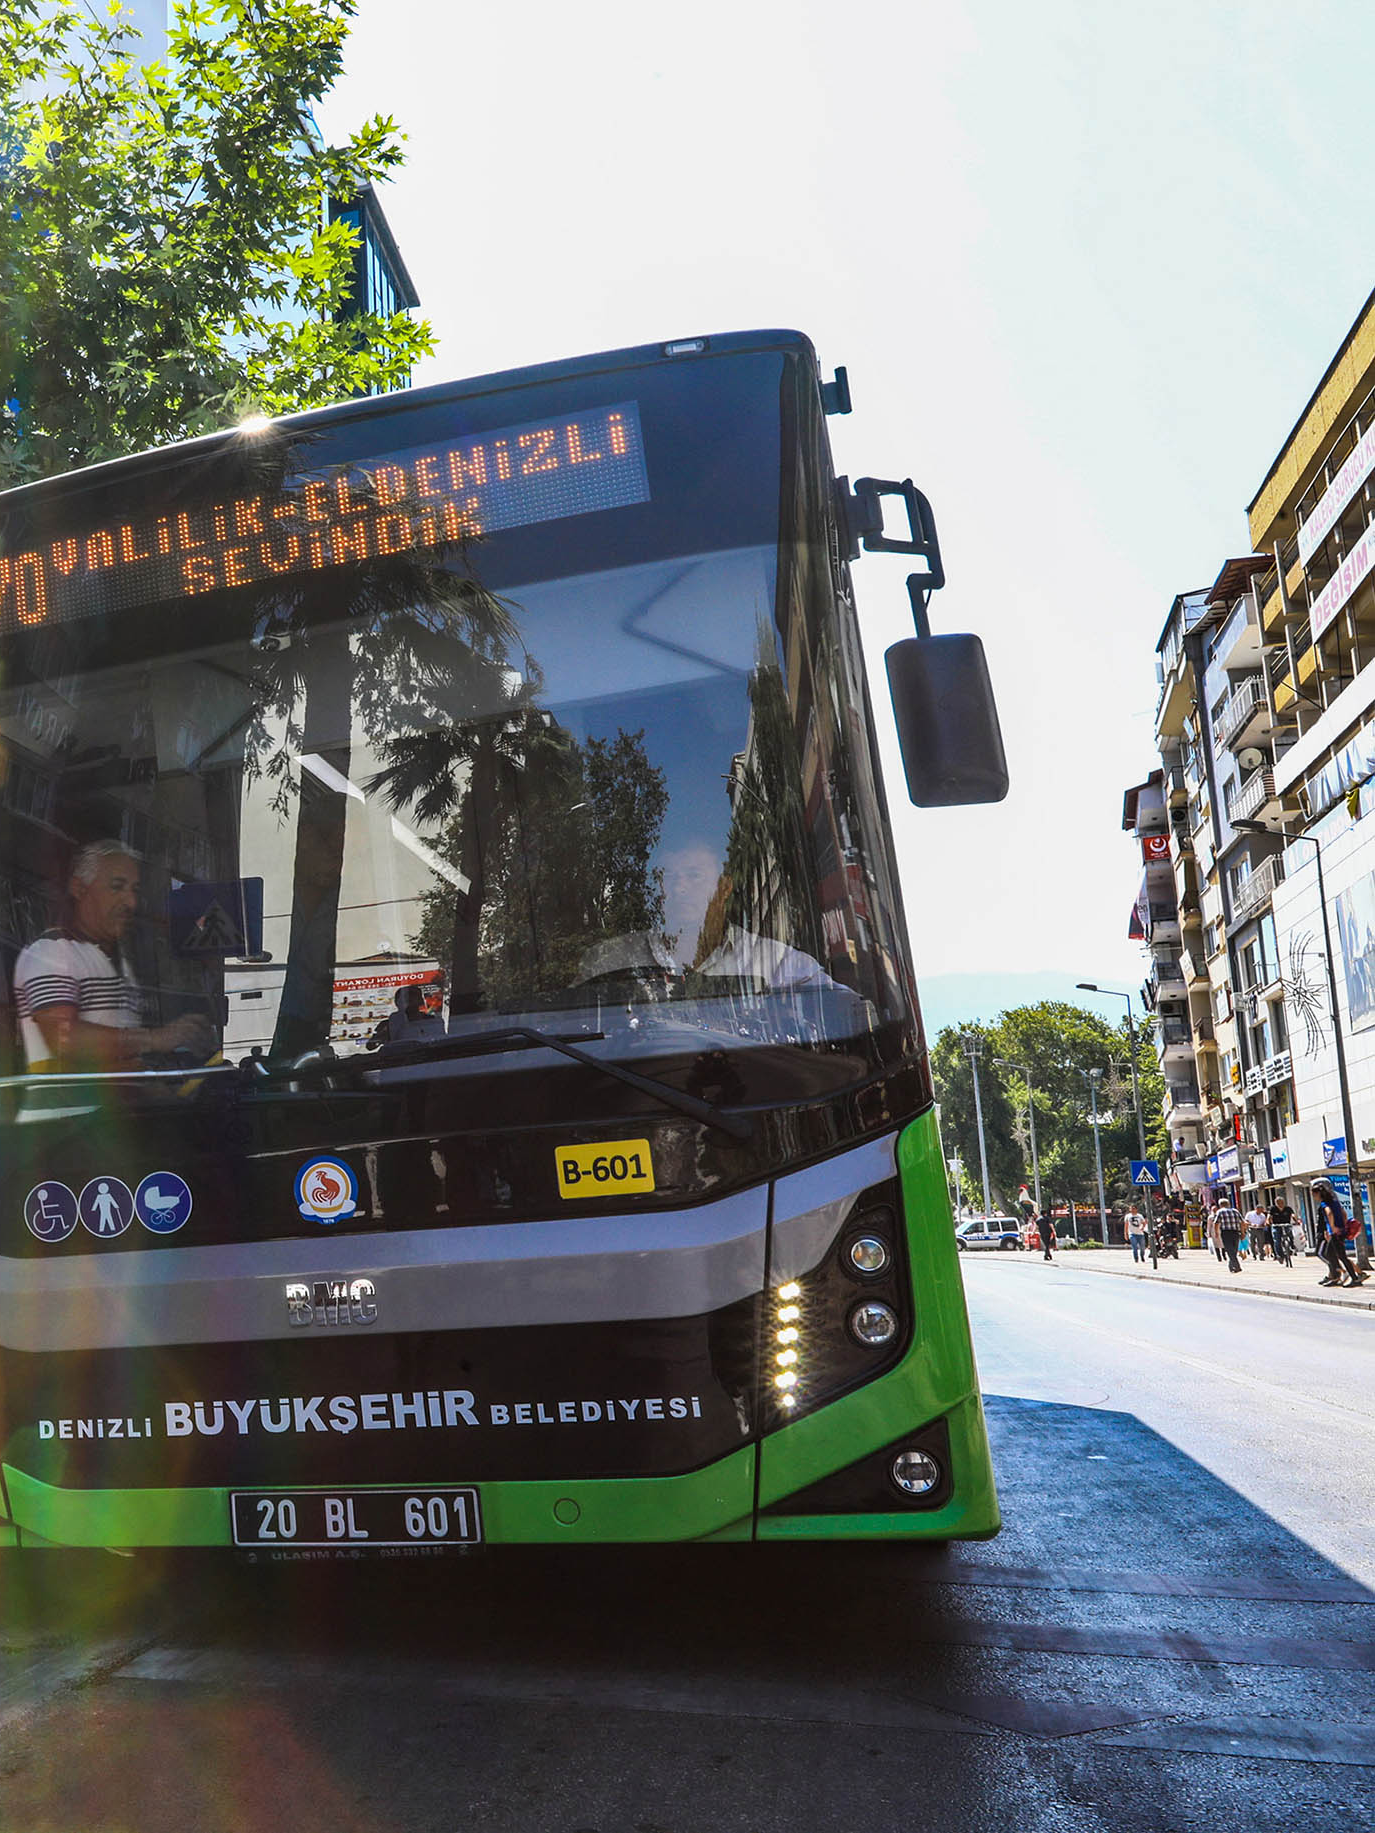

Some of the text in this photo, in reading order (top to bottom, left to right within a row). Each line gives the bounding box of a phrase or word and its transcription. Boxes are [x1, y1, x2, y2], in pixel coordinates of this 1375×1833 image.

[181, 497, 483, 596] SEVİNDİK
[1314, 541, 1369, 631] DEĞİŞİM
[562, 1153, 648, 1185] B-601
[286, 1278, 379, 1328] BMC
[38, 1389, 703, 1440] DENİZLİ BÜYÜKŞEHİR BELEDİYESİ
[256, 1496, 470, 1539] 20 BL 601
